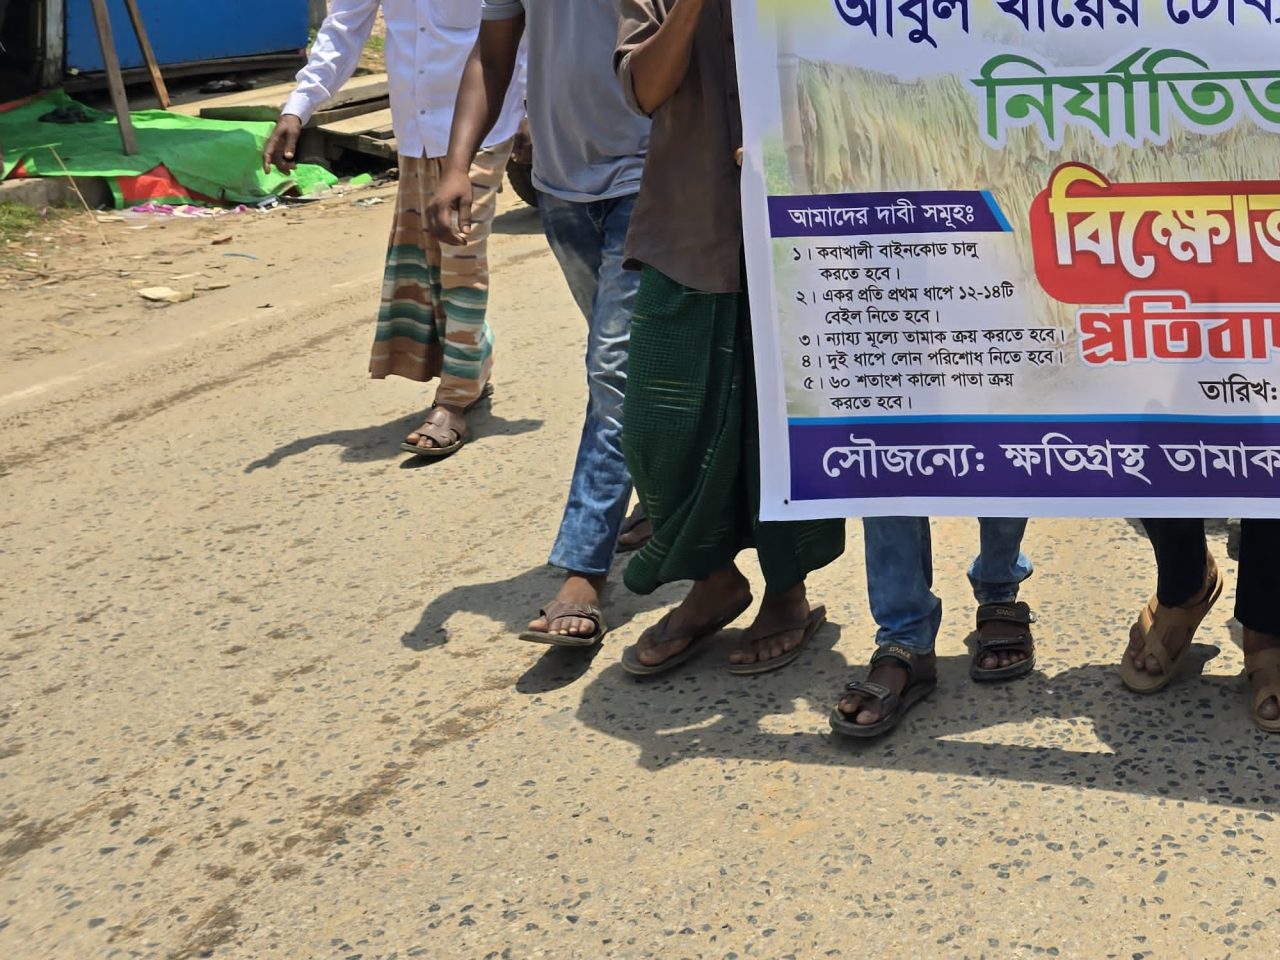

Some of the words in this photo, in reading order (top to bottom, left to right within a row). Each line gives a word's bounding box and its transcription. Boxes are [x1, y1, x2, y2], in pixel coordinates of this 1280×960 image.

[787, 206, 869, 228] আমাদের
[877, 199, 915, 226] দাবী
[816, 240, 874, 260] কবাখালী
[952, 241, 980, 259] চালু
[820, 267, 860, 281] করতে
[822, 288, 854, 303] একর
[858, 283, 884, 303] প্রতি
[887, 286, 919, 303] প্রথম
[923, 285, 954, 301] ধাপে
[825, 309, 862, 325] বেইল
[867, 306, 901, 325] নিতে
[903, 331, 947, 345] তামাক
[951, 330, 977, 345] ক্রয়
[982, 328, 1024, 343] করতে
[826, 351, 849, 369] দুই
[853, 351, 885, 367] ধাপে
[891, 351, 922, 367] লোন
[927, 349, 984, 366] পরিশোধ
[988, 348, 1022, 365] নিতে
[829, 377, 851, 388] ৬০
[856, 374, 904, 389] শতাংশ
[907, 373, 946, 388] কালো
[951, 373, 984, 388] পাতা
[987, 372, 1015, 388] ক্রয়
[830, 396, 871, 411] করতে
[999, 432, 1151, 485] ক্ষতিগ্রস্থ
